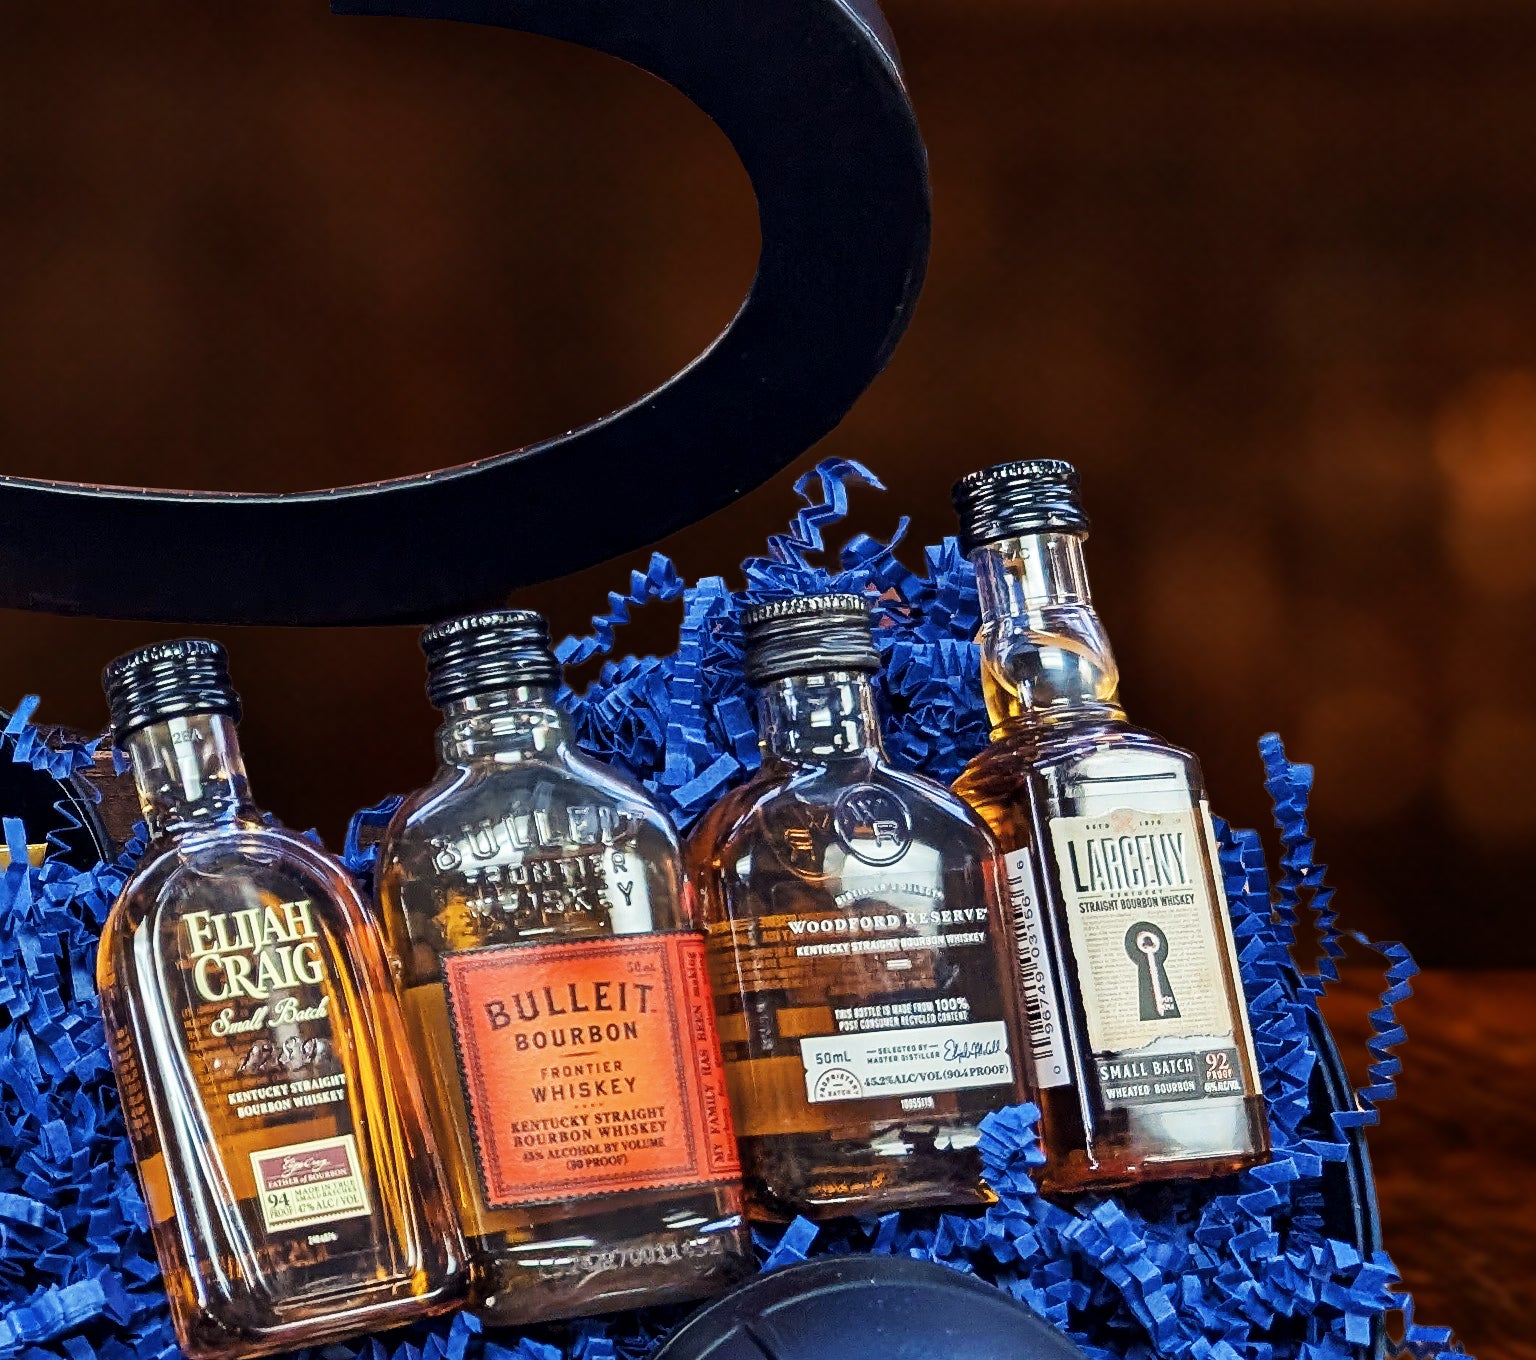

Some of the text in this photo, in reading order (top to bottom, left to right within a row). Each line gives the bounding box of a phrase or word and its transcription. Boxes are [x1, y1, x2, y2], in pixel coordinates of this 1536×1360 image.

[1079, 893, 1195, 914] STRAIGHT BOURBON WHISKEY
[183, 899, 319, 958] ELIJAH
[788, 908, 988, 935] WOODFORD RESERVE
[796, 931, 985, 957] KENTUCKY STRAIGHT BOURBON WHISKEY
[193, 942, 324, 1002] CRAIG
[211, 995, 330, 1036] Small Batch
[484, 981, 653, 1030] BULLEIT
[935, 997, 970, 1012] 100%
[900, 1013, 937, 1026] RECYCLED
[515, 1021, 638, 1051] BOURBON
[699, 1049, 712, 1076] HAS
[878, 1044, 916, 1055] SELECTED
[1205, 1051, 1230, 1071] 92
[540, 1060, 623, 1080] FRONTIER
[1100, 1058, 1194, 1081] SMALL BATCH
[228, 1073, 345, 1105] KENTUCKY STRAIGHT
[531, 1077, 637, 1103] WHISKEY
[1106, 1080, 1196, 1100] WHEATED BOURBON
[237, 1088, 344, 1119] BOURBON WHISKEY
[706, 1085, 720, 1134] FAMILY
[511, 1106, 665, 1134] KENTUCKY STRAIGHT
[514, 1121, 667, 1147] BOURBON WHISKEY
[547, 1144, 601, 1160] ALCOHOL
[623, 1137, 666, 1152] VOLUME
[308, 1168, 348, 1182] BOURBON
[267, 1192, 290, 1208] 94
